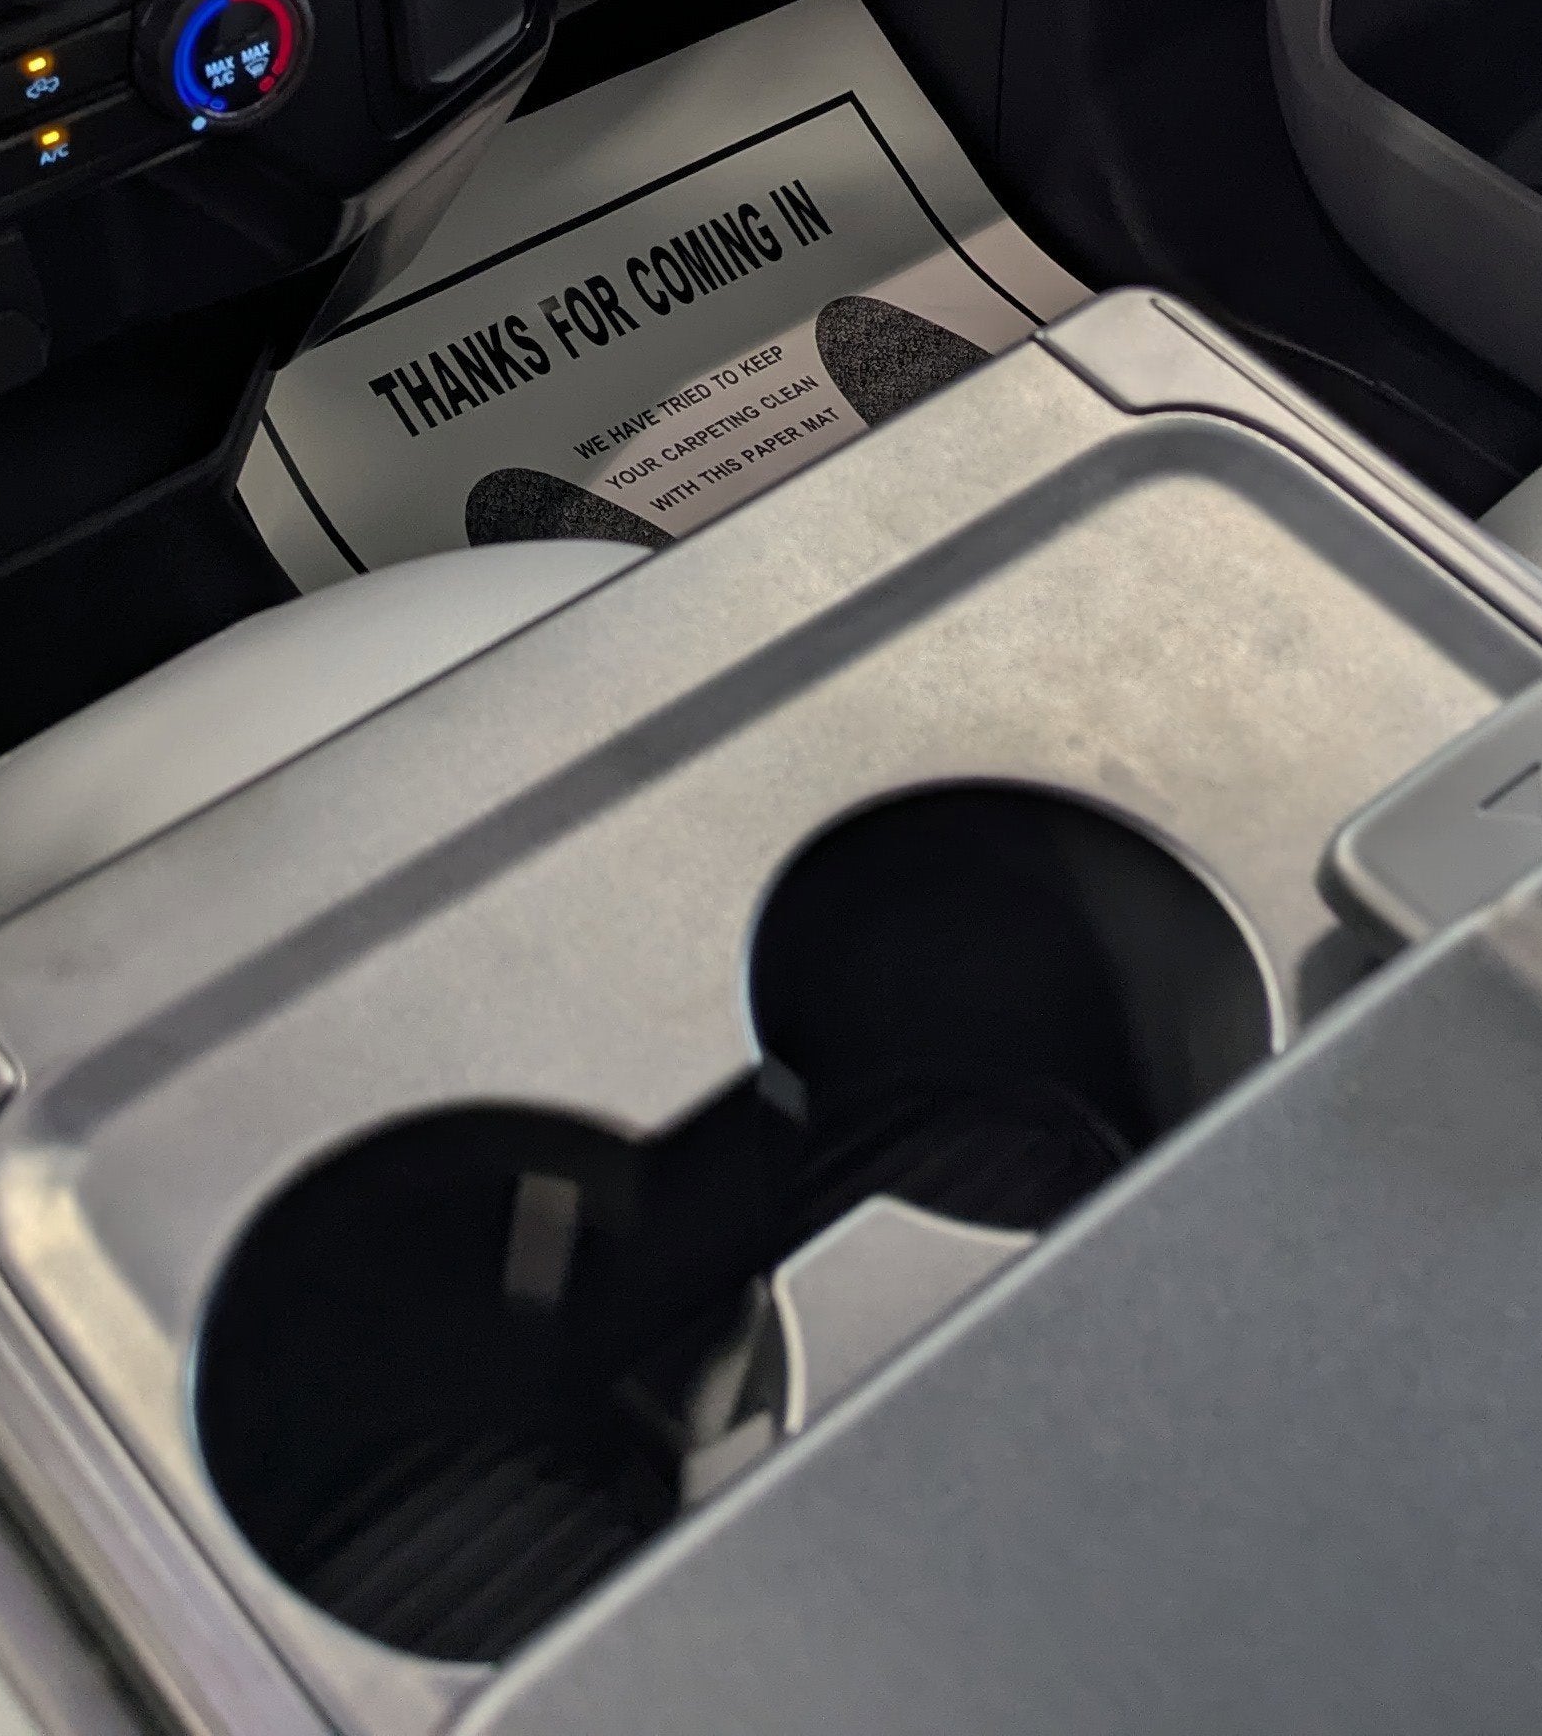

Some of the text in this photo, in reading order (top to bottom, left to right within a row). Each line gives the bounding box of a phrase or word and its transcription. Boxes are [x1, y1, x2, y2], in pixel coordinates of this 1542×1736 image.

[205, 55, 236, 79] MAX
[240, 40, 271, 65] MAX
[39, 142, 70, 166] A/C
[368, 179, 834, 438] THANKS FOR COMING IN
[572, 344, 785, 461] WE HAVE TRIED TO KEEP
[604, 374, 821, 494] YOUR CARPETING CLEAN
[649, 406, 843, 515] WITH THIS PAPER MAT
